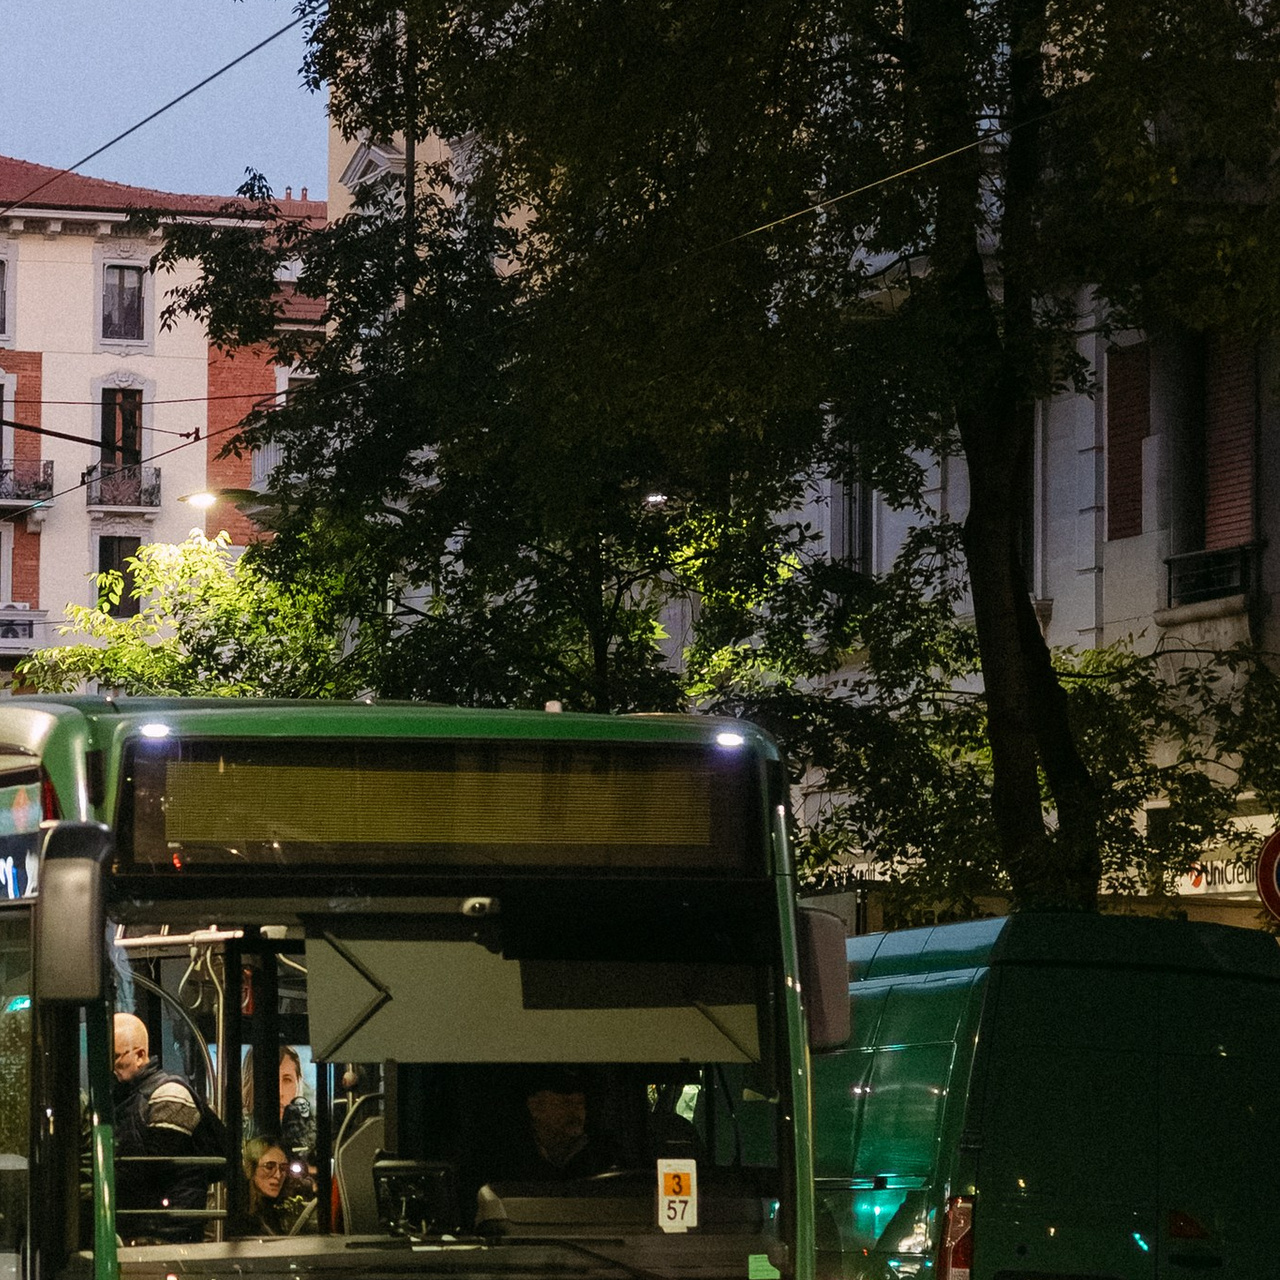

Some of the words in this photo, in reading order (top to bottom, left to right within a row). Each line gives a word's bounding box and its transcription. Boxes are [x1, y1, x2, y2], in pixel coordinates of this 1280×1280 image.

[1204, 858, 1258, 886] UniCredi
[672, 1174, 683, 1195] 3
[667, 1200, 688, 1220] 57
